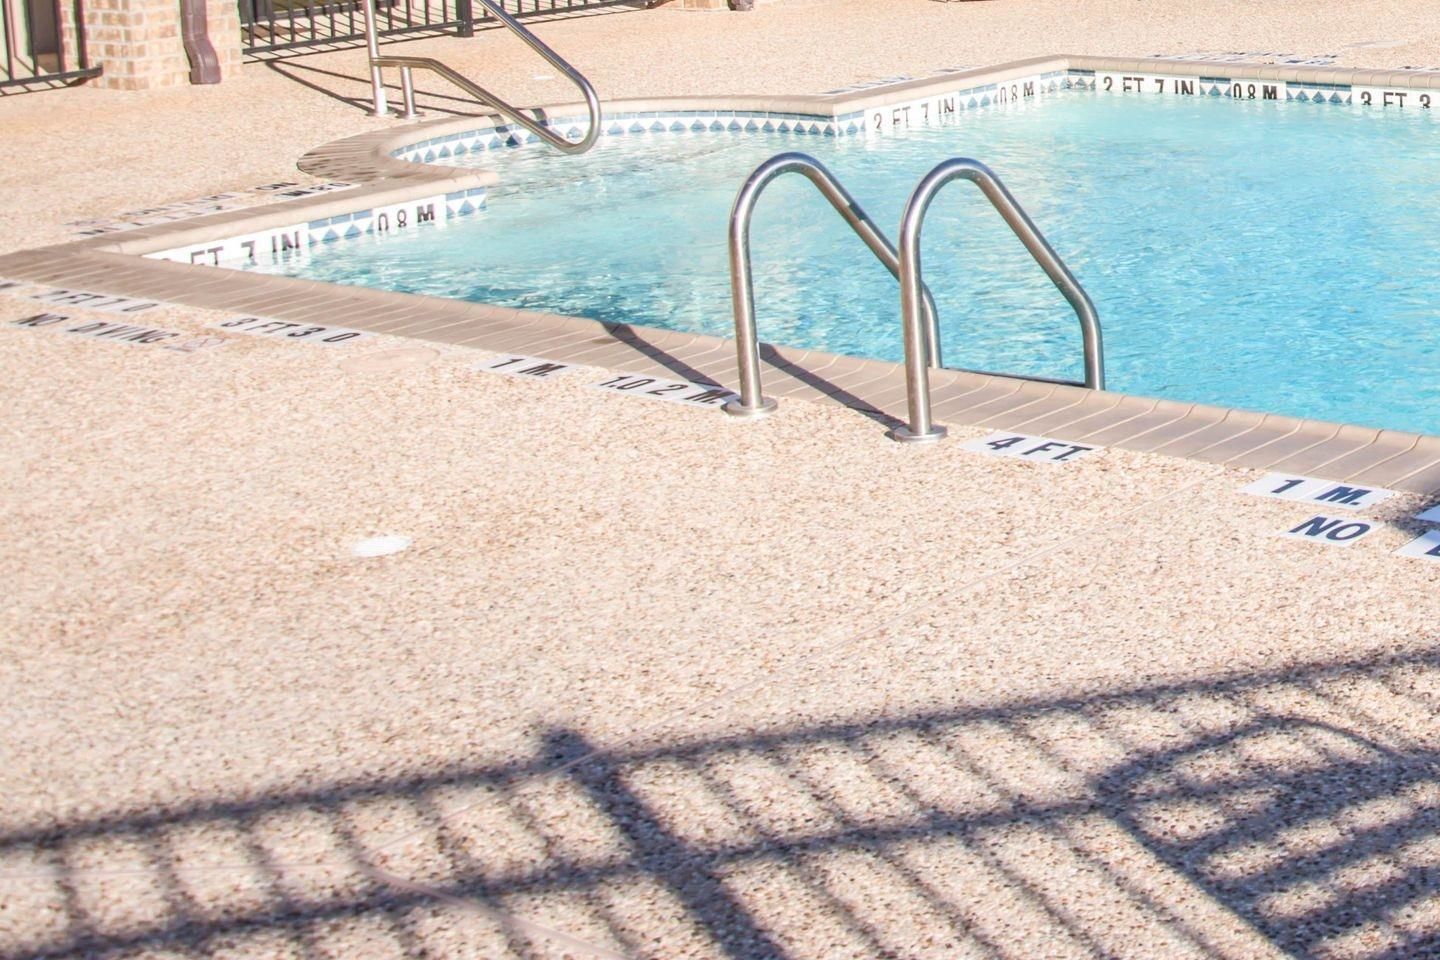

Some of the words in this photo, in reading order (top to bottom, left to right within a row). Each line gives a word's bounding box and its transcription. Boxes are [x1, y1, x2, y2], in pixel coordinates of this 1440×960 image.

[1155, 79, 1164, 93] 7
[1175, 79, 1194, 95] IN
[66, 322, 181, 344] DIVING
[491, 358, 524, 369] 1
[986, 436, 1025, 452] 4
[1269, 479, 1305, 495] 1
[1288, 515, 1371, 543] NO
